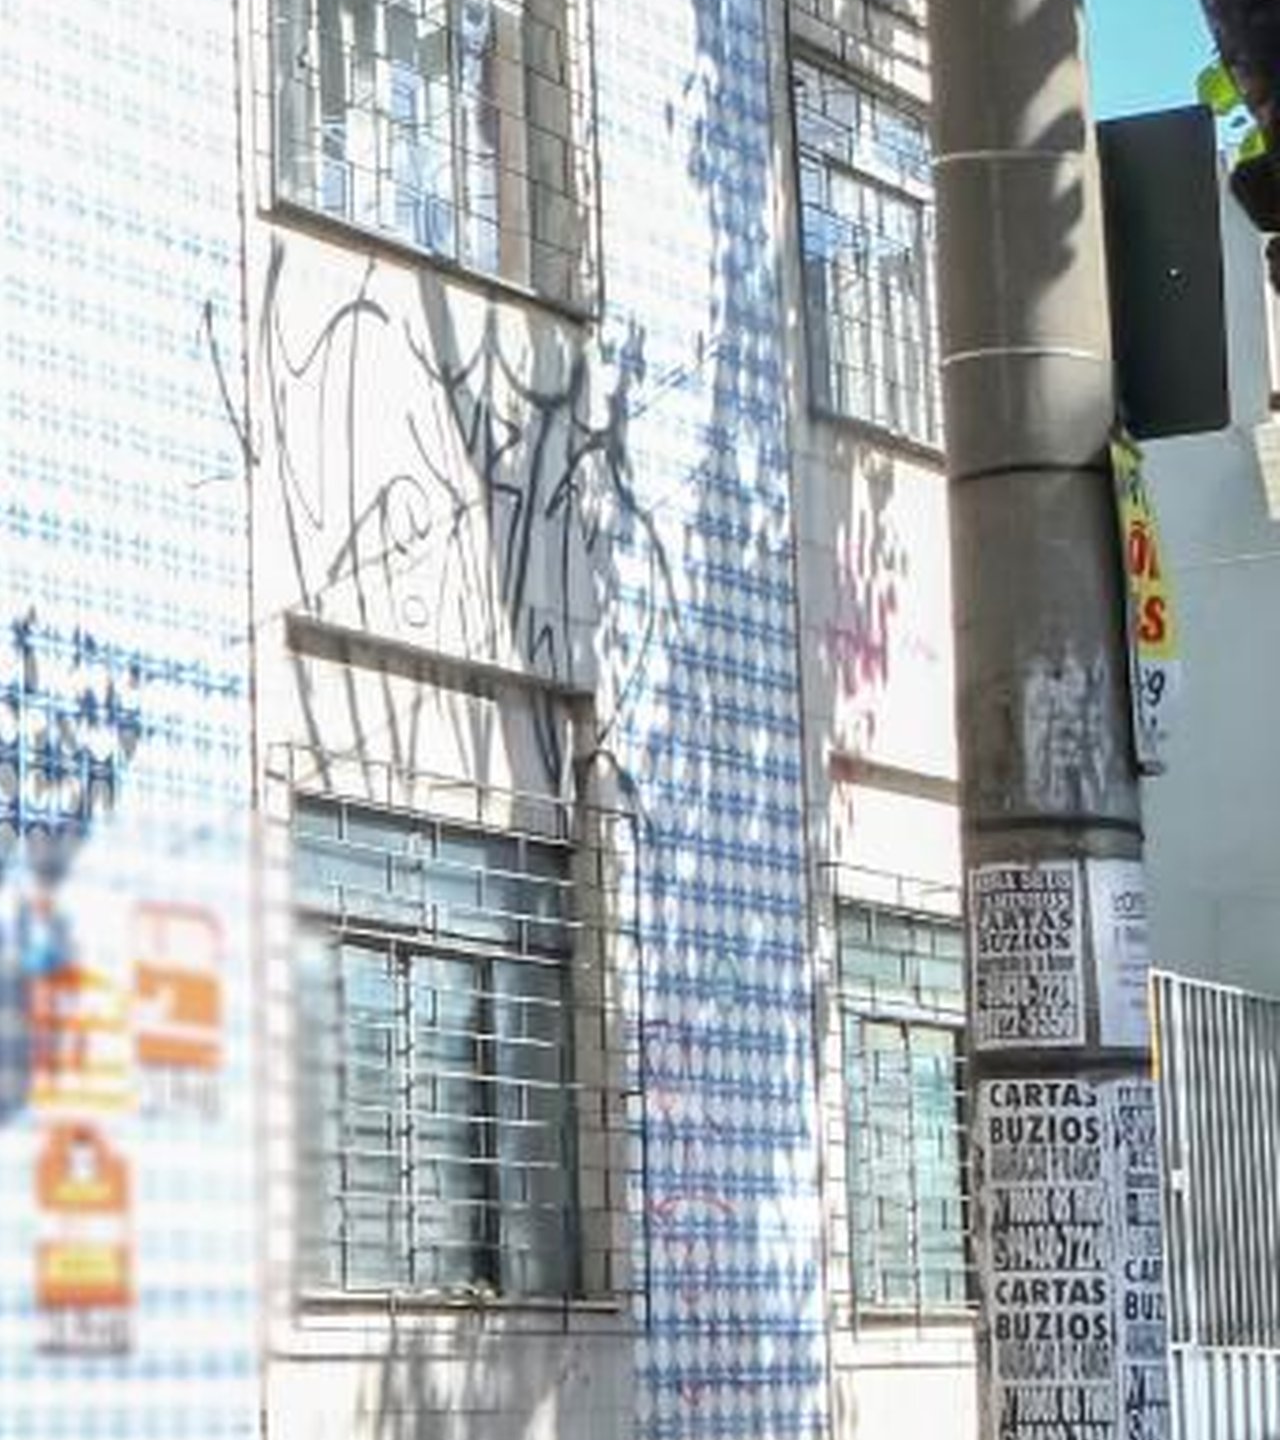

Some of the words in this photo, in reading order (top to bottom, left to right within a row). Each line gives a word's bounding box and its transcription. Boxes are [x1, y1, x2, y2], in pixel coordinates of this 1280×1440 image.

[990, 1083, 1098, 1107] CARTAS
[990, 1117, 1100, 1144] BUZIOS
[995, 1279, 1106, 1305] CARTAS
[995, 1313, 1108, 1340] BUZIOS
